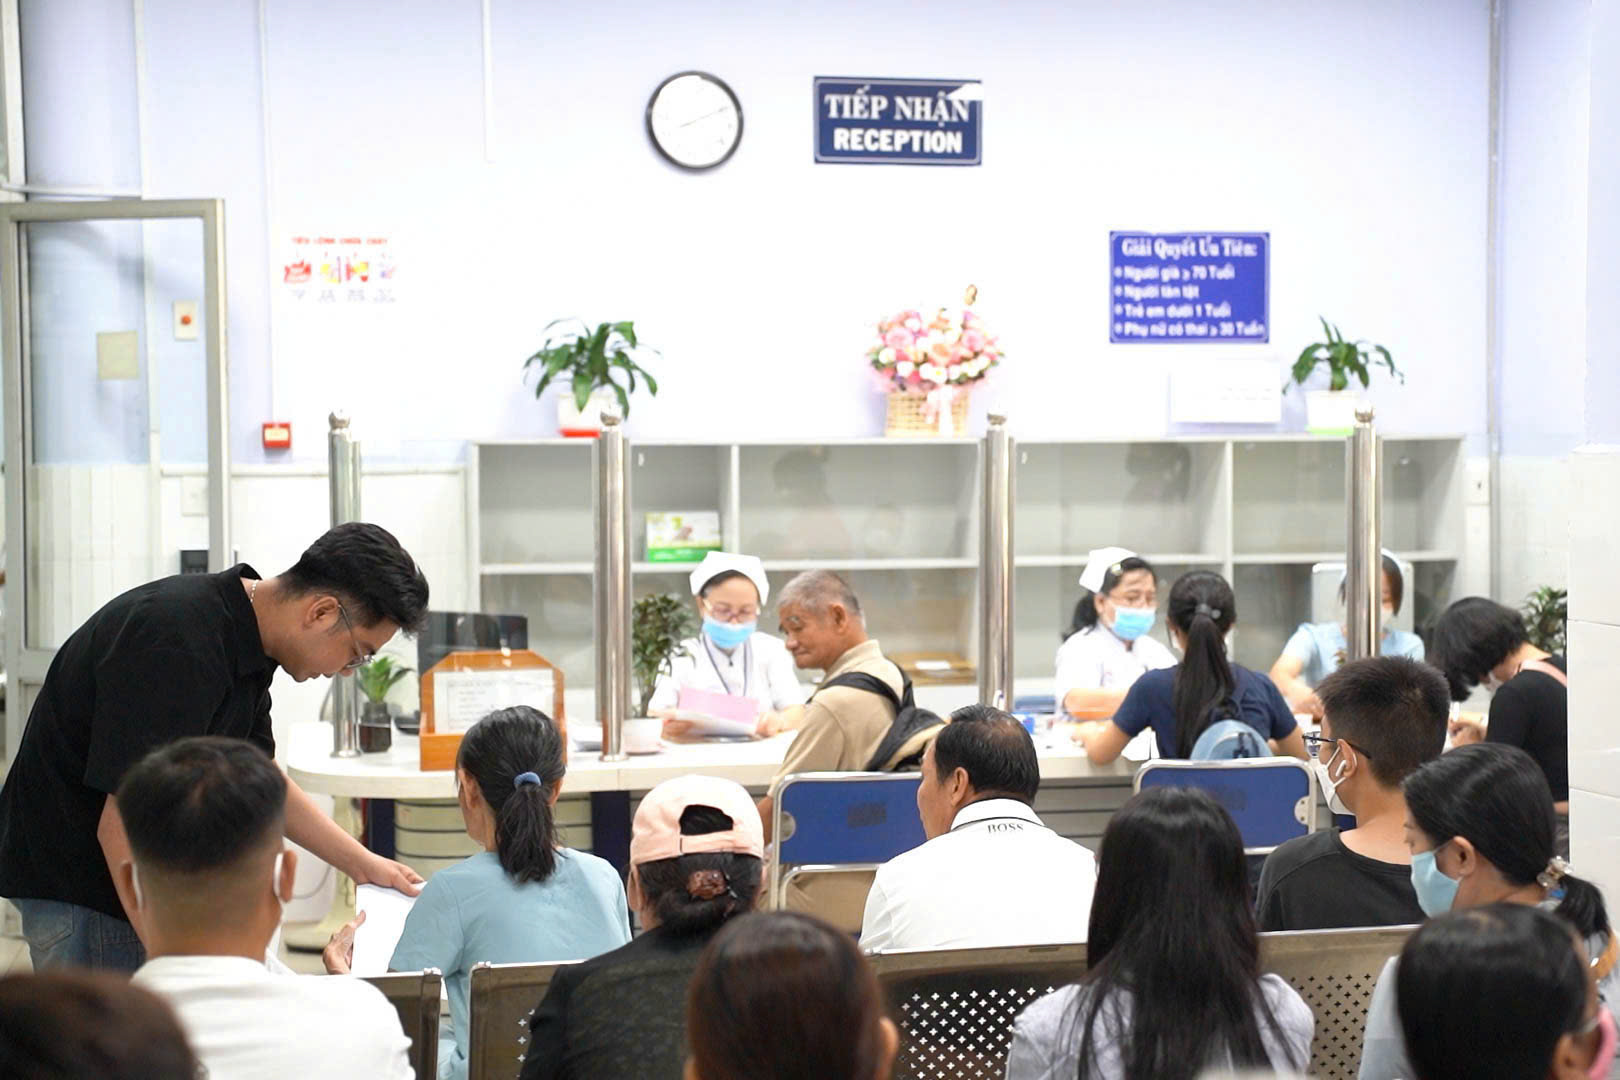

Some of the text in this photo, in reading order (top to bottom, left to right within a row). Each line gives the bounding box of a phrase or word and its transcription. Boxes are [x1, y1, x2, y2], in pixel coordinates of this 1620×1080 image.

[824, 85, 970, 127] TIẾP NHẬN
[834, 127, 962, 153] RECEPTION
[987, 822, 1024, 834] BOSS
